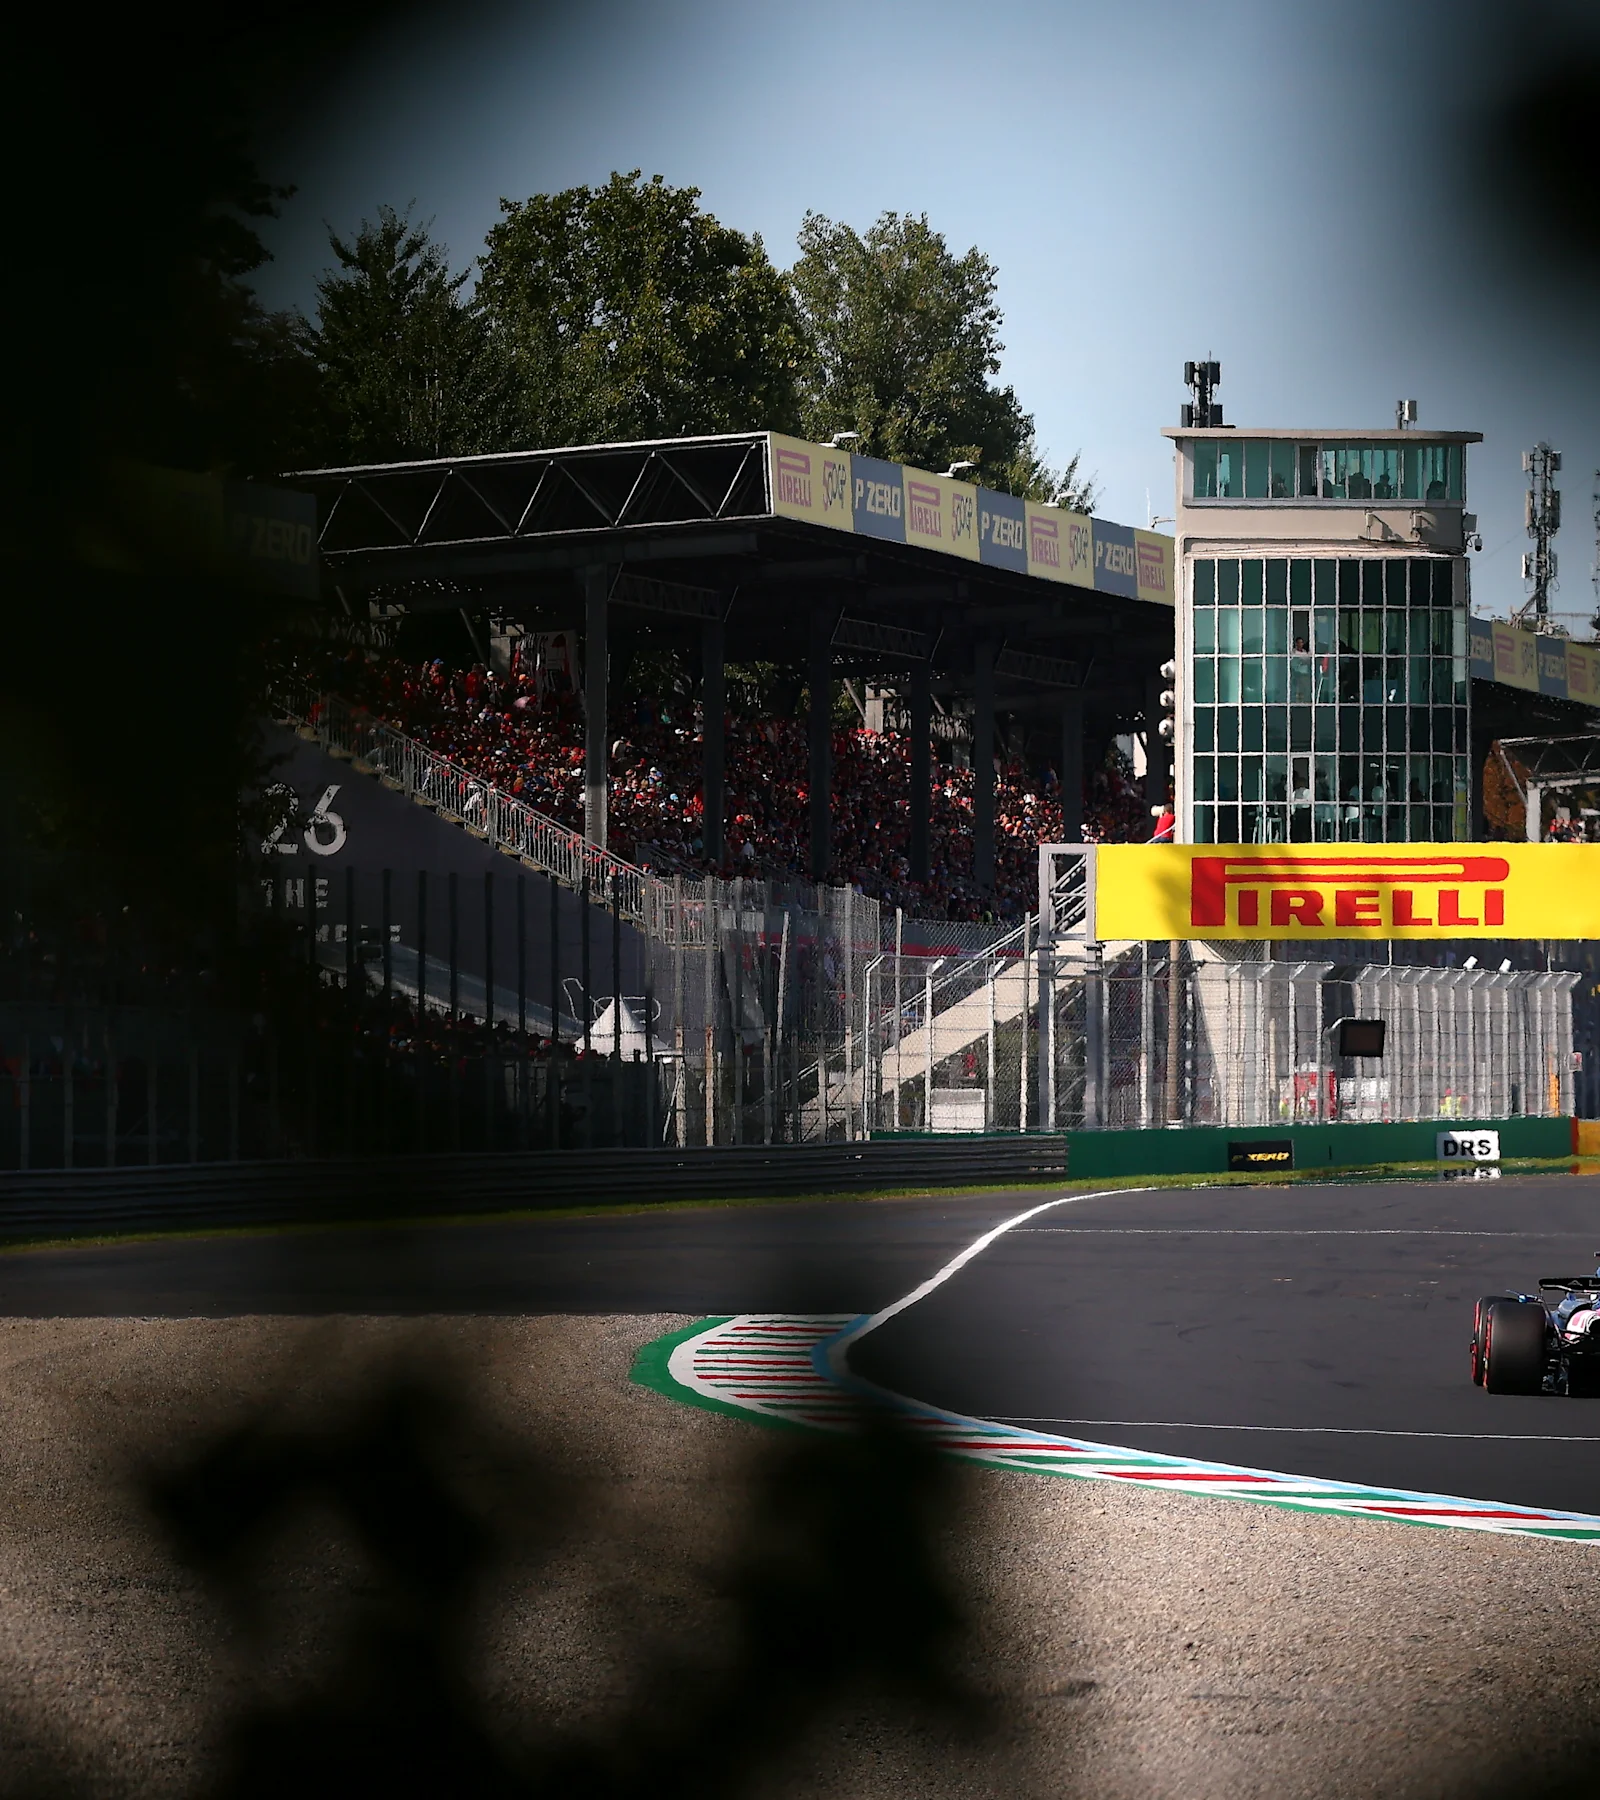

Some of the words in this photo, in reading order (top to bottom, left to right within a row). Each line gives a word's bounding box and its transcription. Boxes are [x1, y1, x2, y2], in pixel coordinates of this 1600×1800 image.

[776, 448, 812, 507] PIRELLI
[855, 478, 864, 509] P
[867, 481, 901, 518] ZERO
[908, 481, 942, 537] PIRELLI
[981, 511, 990, 540] P
[991, 516, 1023, 549] ZERO
[1030, 515, 1060, 568] PIRELLI
[1095, 541, 1103, 567] P
[1105, 544, 1135, 576] ZERO
[1137, 541, 1166, 591] PIRELLI
[1191, 857, 1510, 926] PIRELLI
[1443, 1139, 1491, 1156] DRS
